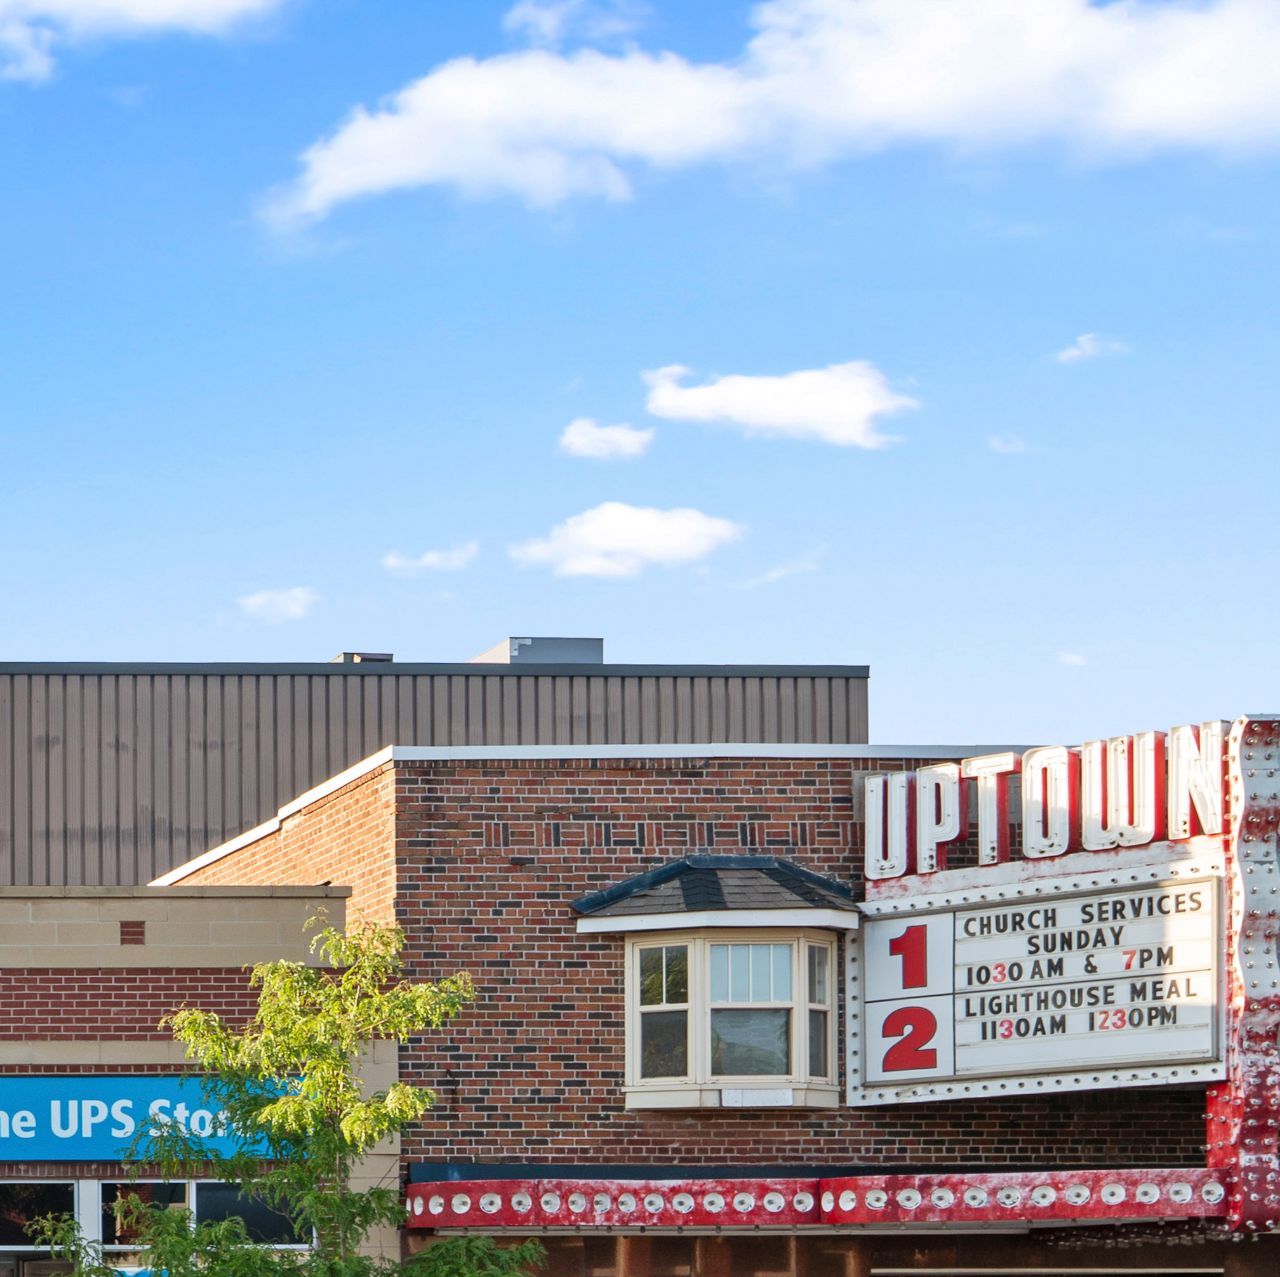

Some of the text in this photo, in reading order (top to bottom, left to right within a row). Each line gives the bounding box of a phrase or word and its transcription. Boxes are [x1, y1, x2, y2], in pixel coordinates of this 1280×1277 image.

[864, 719, 1232, 881] UPTOWN
[963, 891, 1203, 937] CHURCH SERVICES
[889, 923, 928, 989] 1
[1027, 925, 1124, 955] SUNDAY
[1084, 953, 1098, 974] &
[1121, 946, 1174, 971] 7PM
[964, 977, 1198, 1018] LIGHTHOUSE MEAL
[881, 1006, 938, 1072] 2
[981, 1005, 1178, 1041] 1130AM 1230PM
[49, 1099, 136, 1139] UPS
[148, 1099, 252, 1139] Stor
